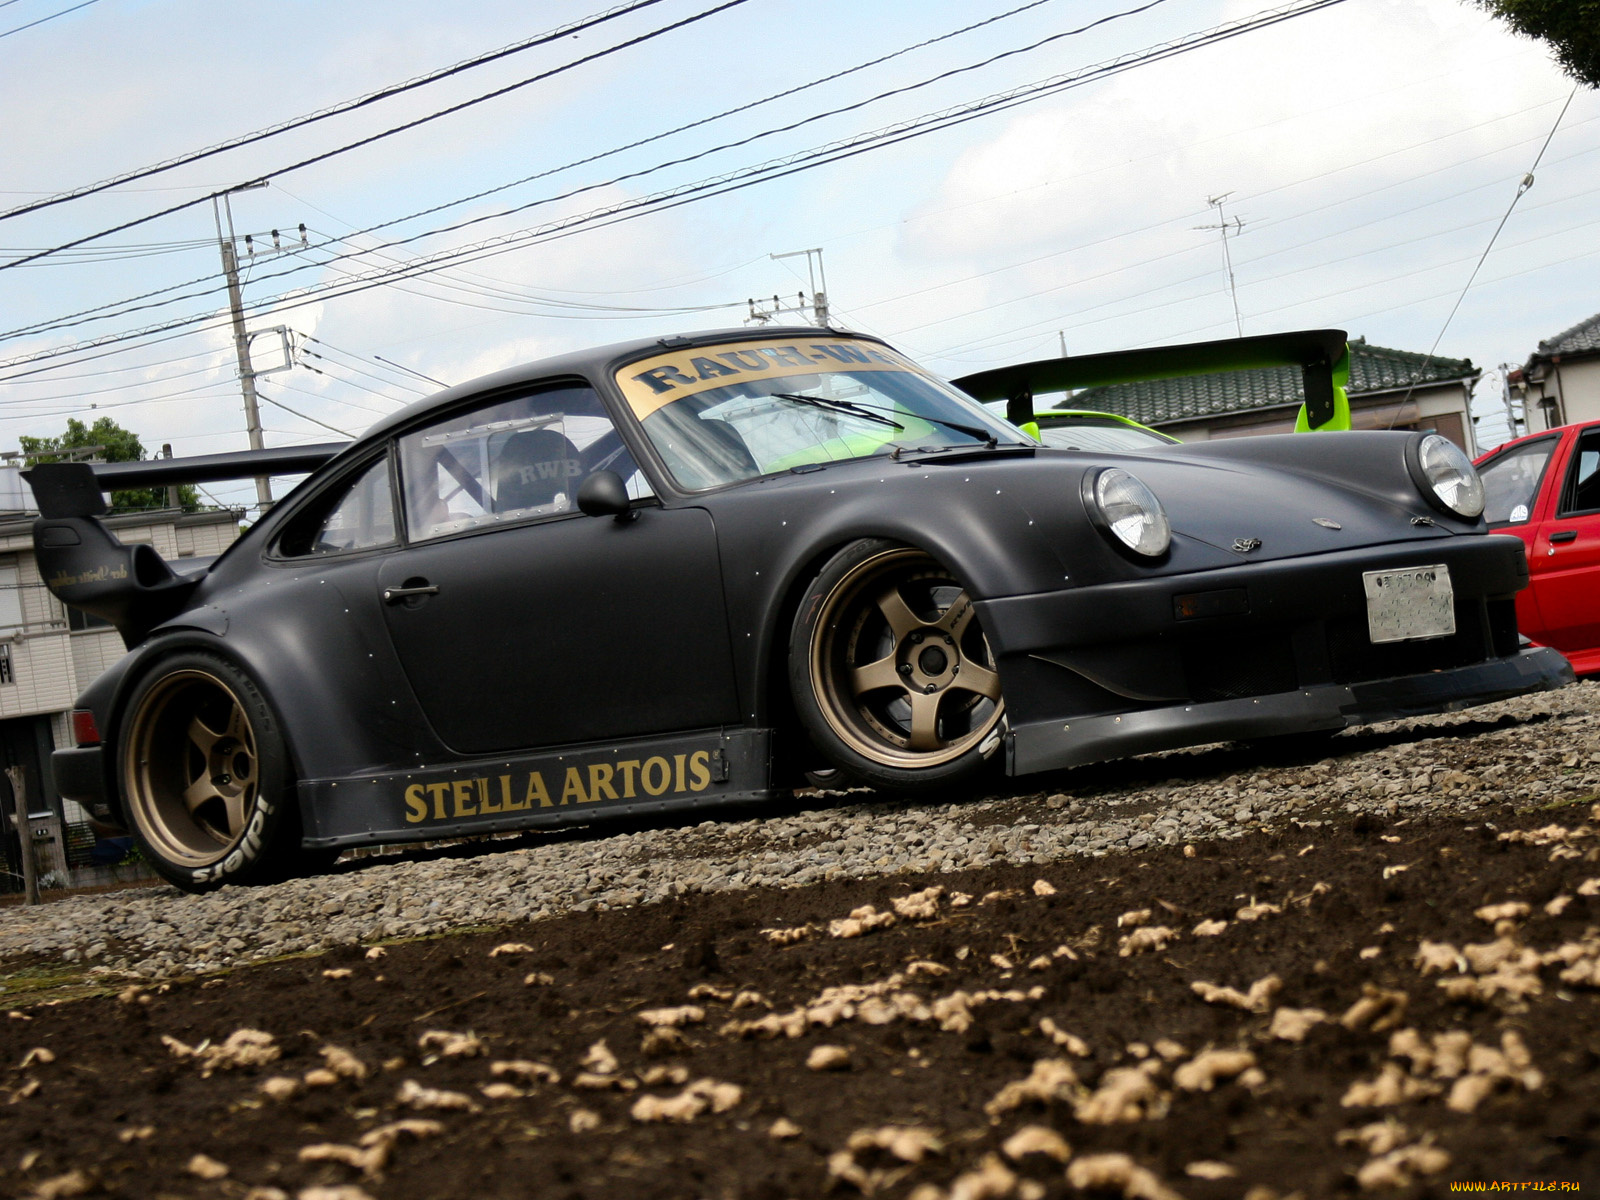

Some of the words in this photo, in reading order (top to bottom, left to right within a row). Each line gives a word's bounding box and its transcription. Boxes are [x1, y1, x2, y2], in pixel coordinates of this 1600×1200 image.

[520, 458, 583, 485] RWB
[404, 770, 553, 824] STELLA
[559, 750, 711, 806] ARTOIS
